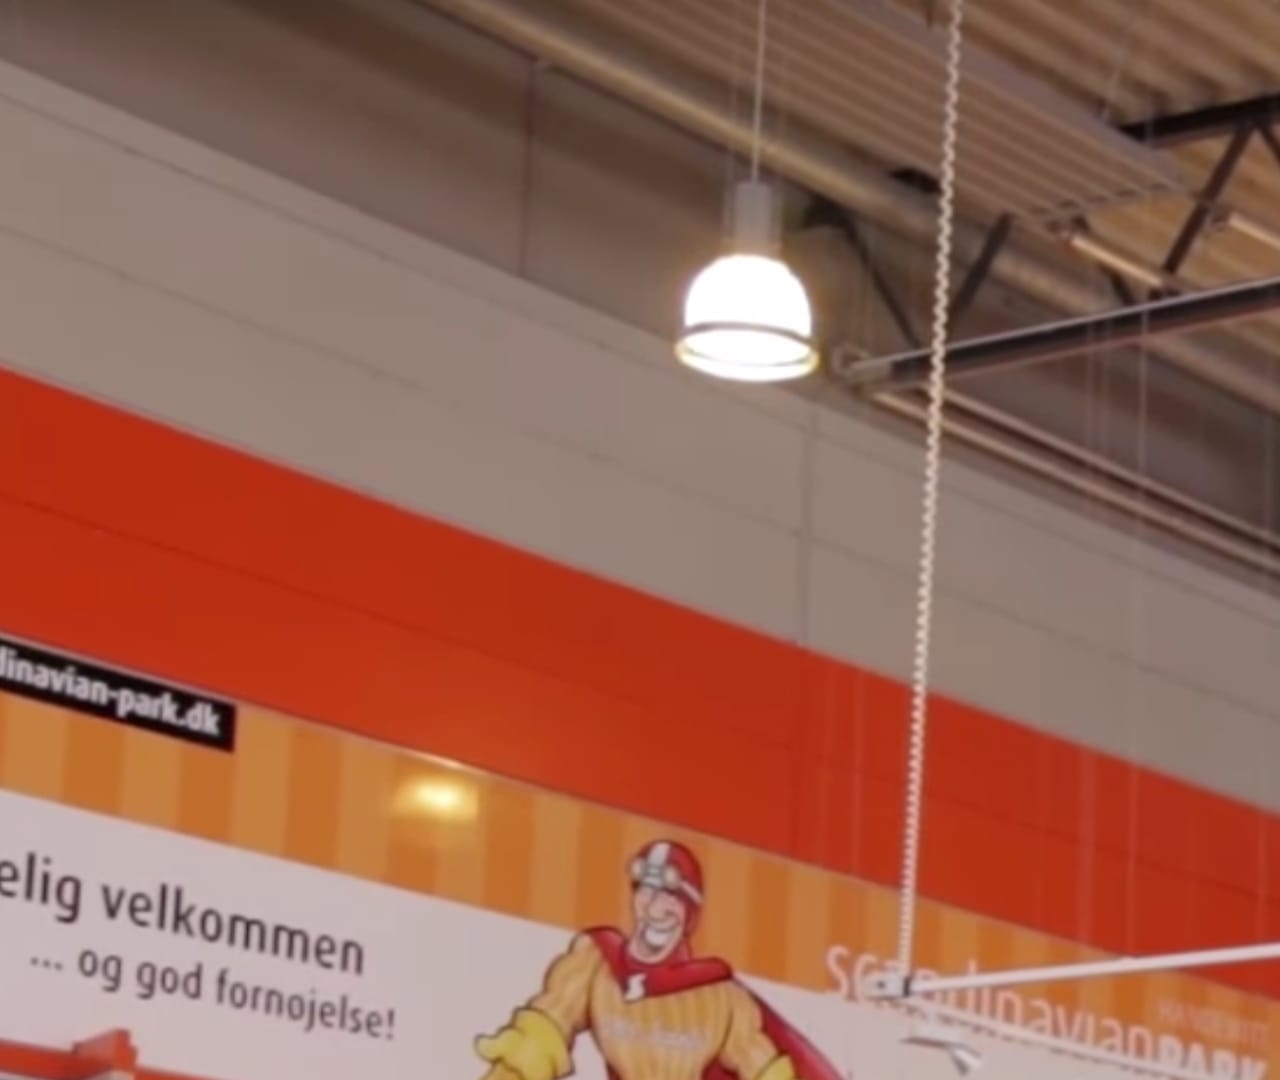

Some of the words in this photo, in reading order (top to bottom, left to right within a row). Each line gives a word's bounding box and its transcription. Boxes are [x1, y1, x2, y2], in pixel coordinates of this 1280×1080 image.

[0, 852, 82, 925] elig
[102, 882, 365, 976] velkommen
[78, 949, 122, 993] og
[136, 961, 203, 1001] god
